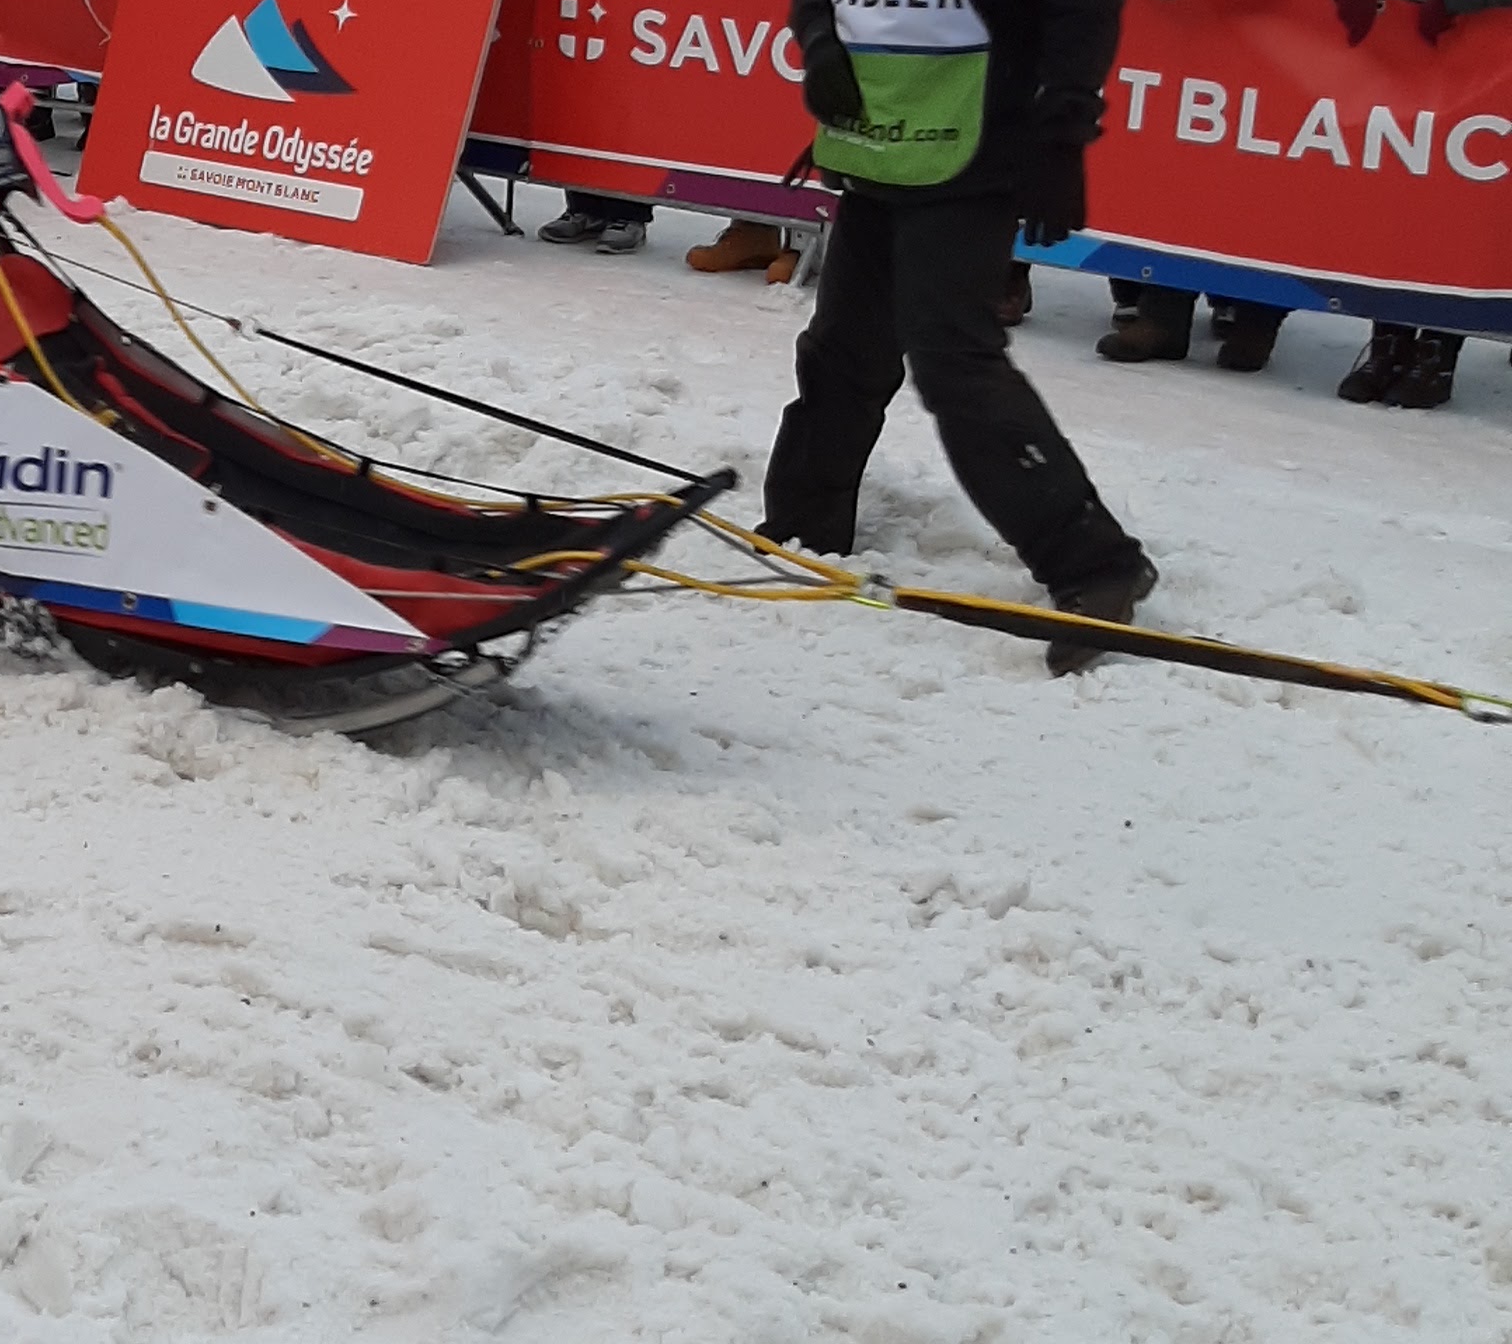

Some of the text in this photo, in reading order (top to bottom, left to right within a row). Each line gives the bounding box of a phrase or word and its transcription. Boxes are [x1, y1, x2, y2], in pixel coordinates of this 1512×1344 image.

[149, 104, 374, 175] la Grande Odyssée
[1176, 77, 1512, 181] BLANC
[190, 167, 320, 203] SAVOIE MONT BLANC
